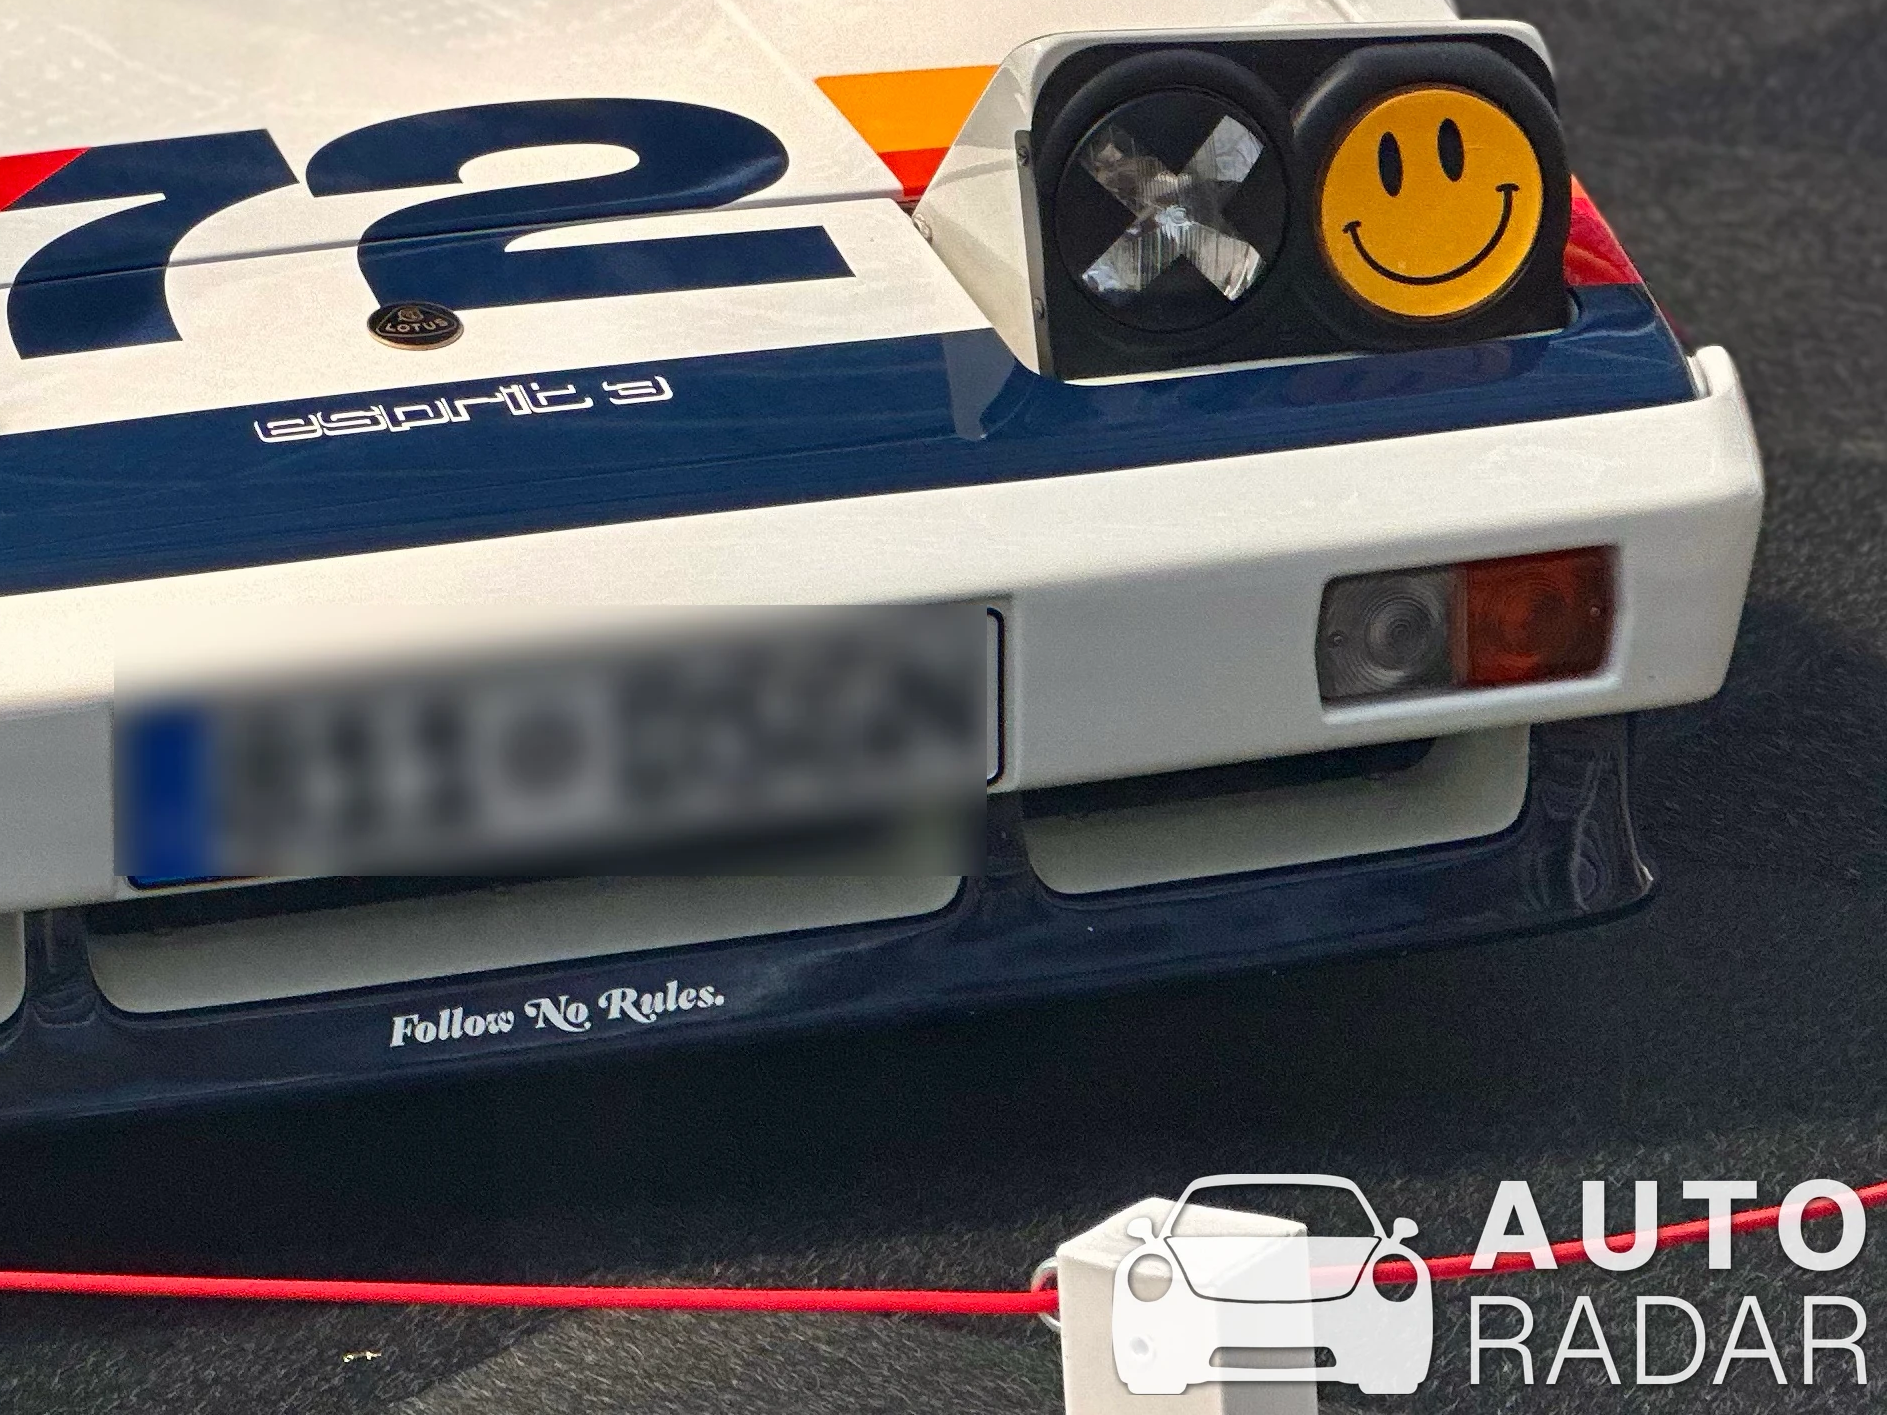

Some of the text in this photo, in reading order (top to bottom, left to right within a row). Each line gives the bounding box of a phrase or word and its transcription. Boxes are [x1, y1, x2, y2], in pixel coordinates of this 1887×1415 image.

[1, 98, 856, 361] 72
[385, 318, 449, 333] LOTUS
[253, 382, 595, 443] esprit
[389, 980, 725, 1048] Follow No Rules.
